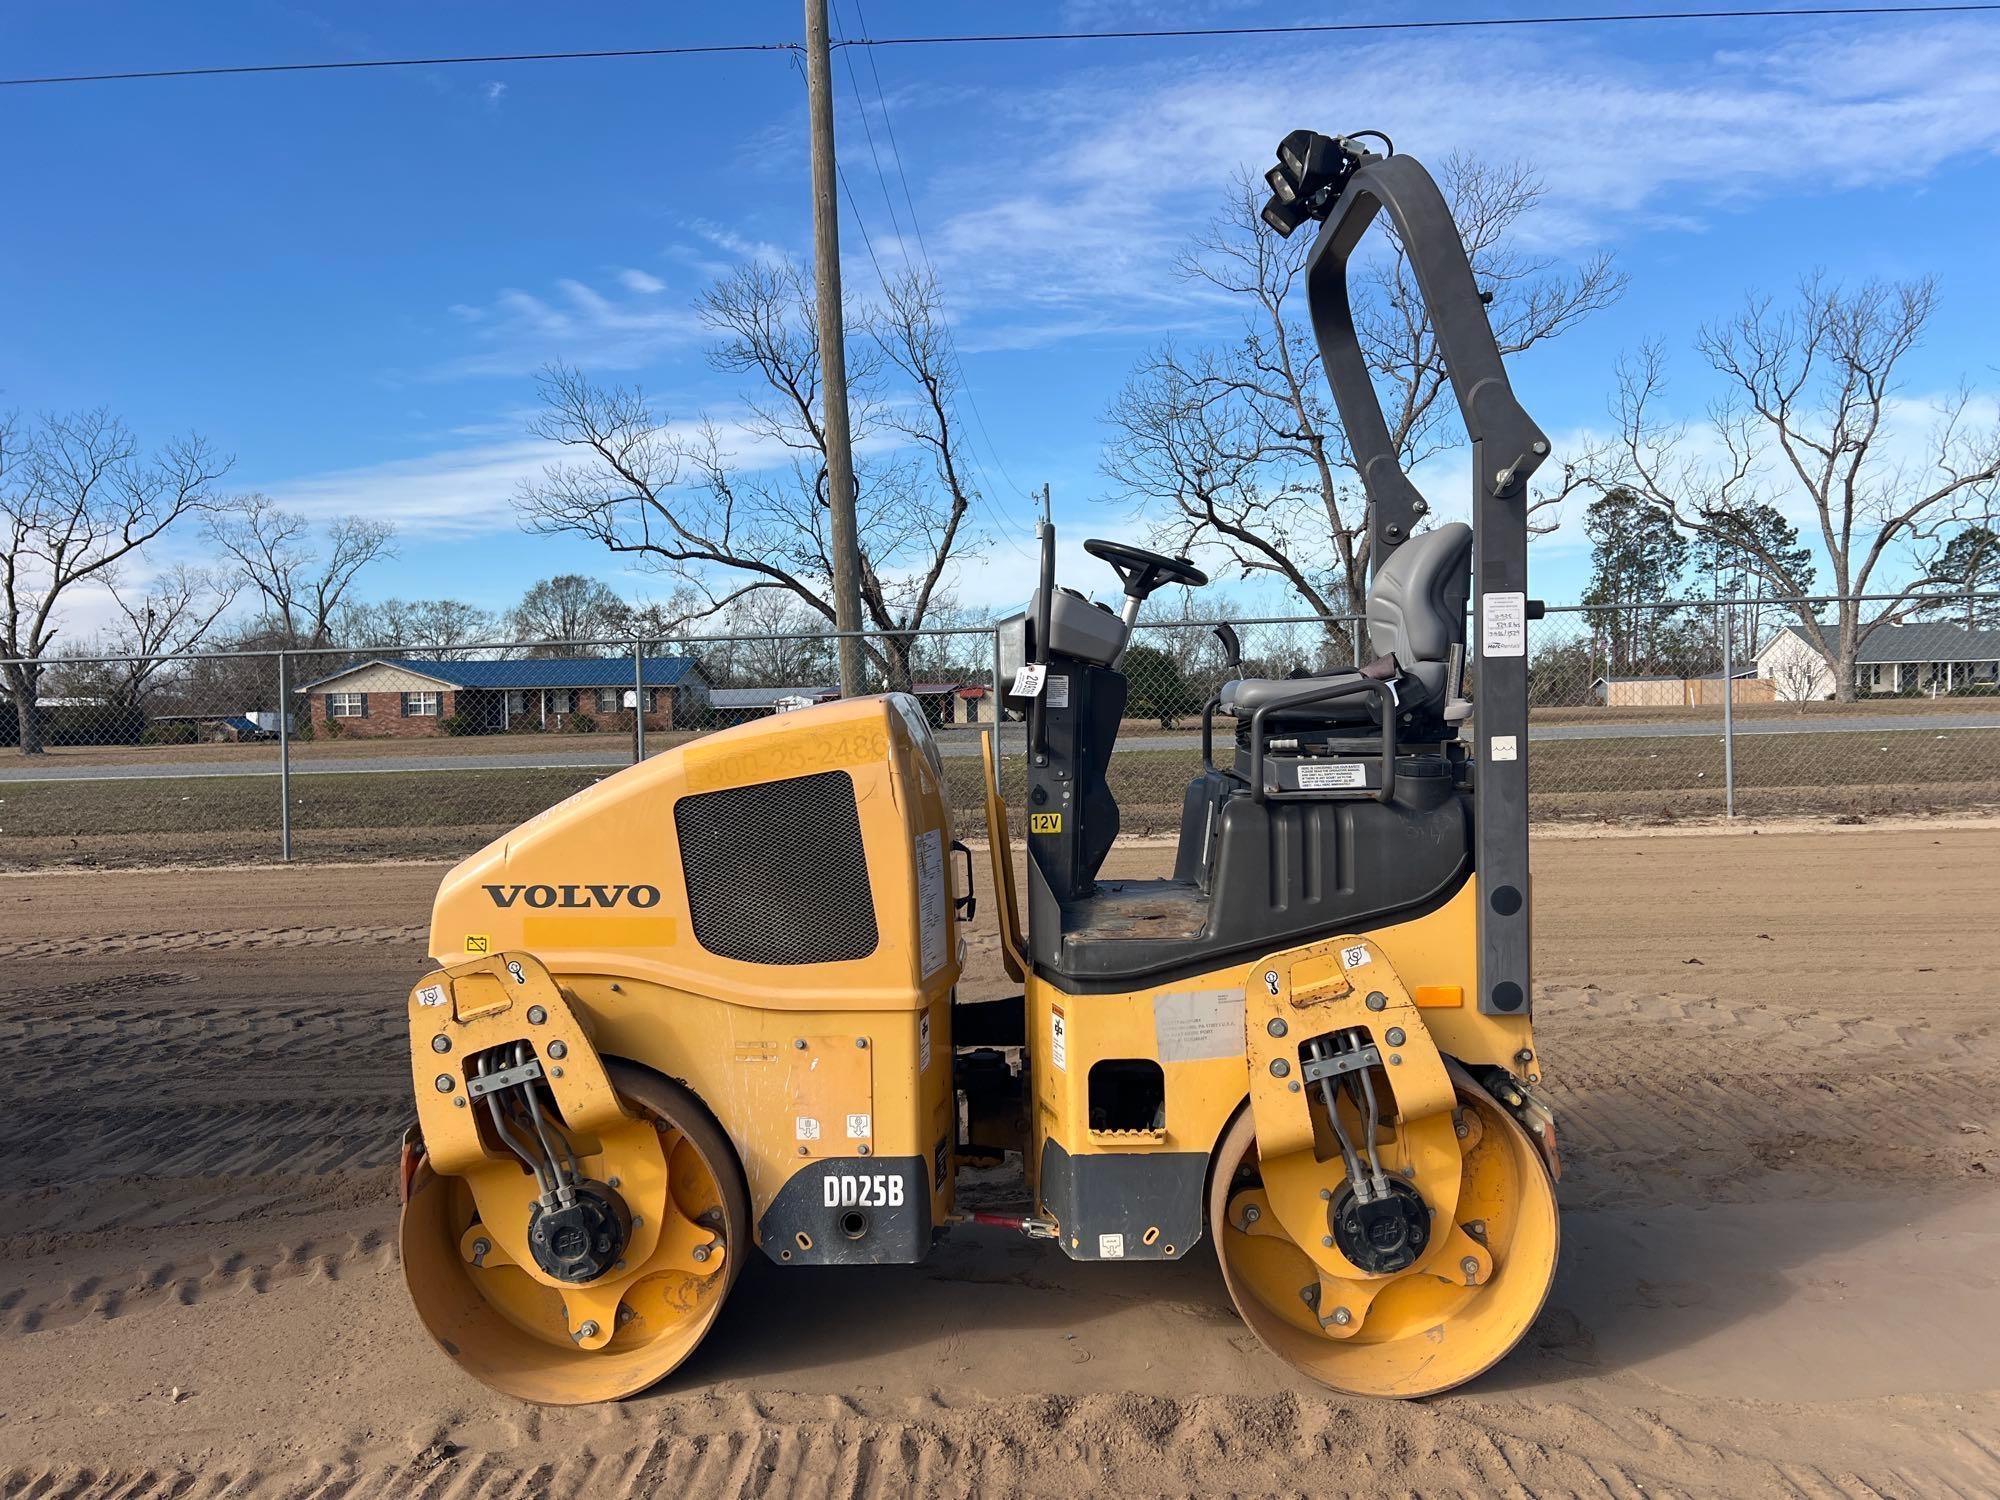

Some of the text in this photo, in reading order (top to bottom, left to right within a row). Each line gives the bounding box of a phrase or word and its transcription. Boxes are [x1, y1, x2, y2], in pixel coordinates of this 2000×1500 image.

[1033, 815, 1059, 829] 12V
[482, 885, 660, 908] VOLVO
[824, 1175, 904, 1207] DD25B
